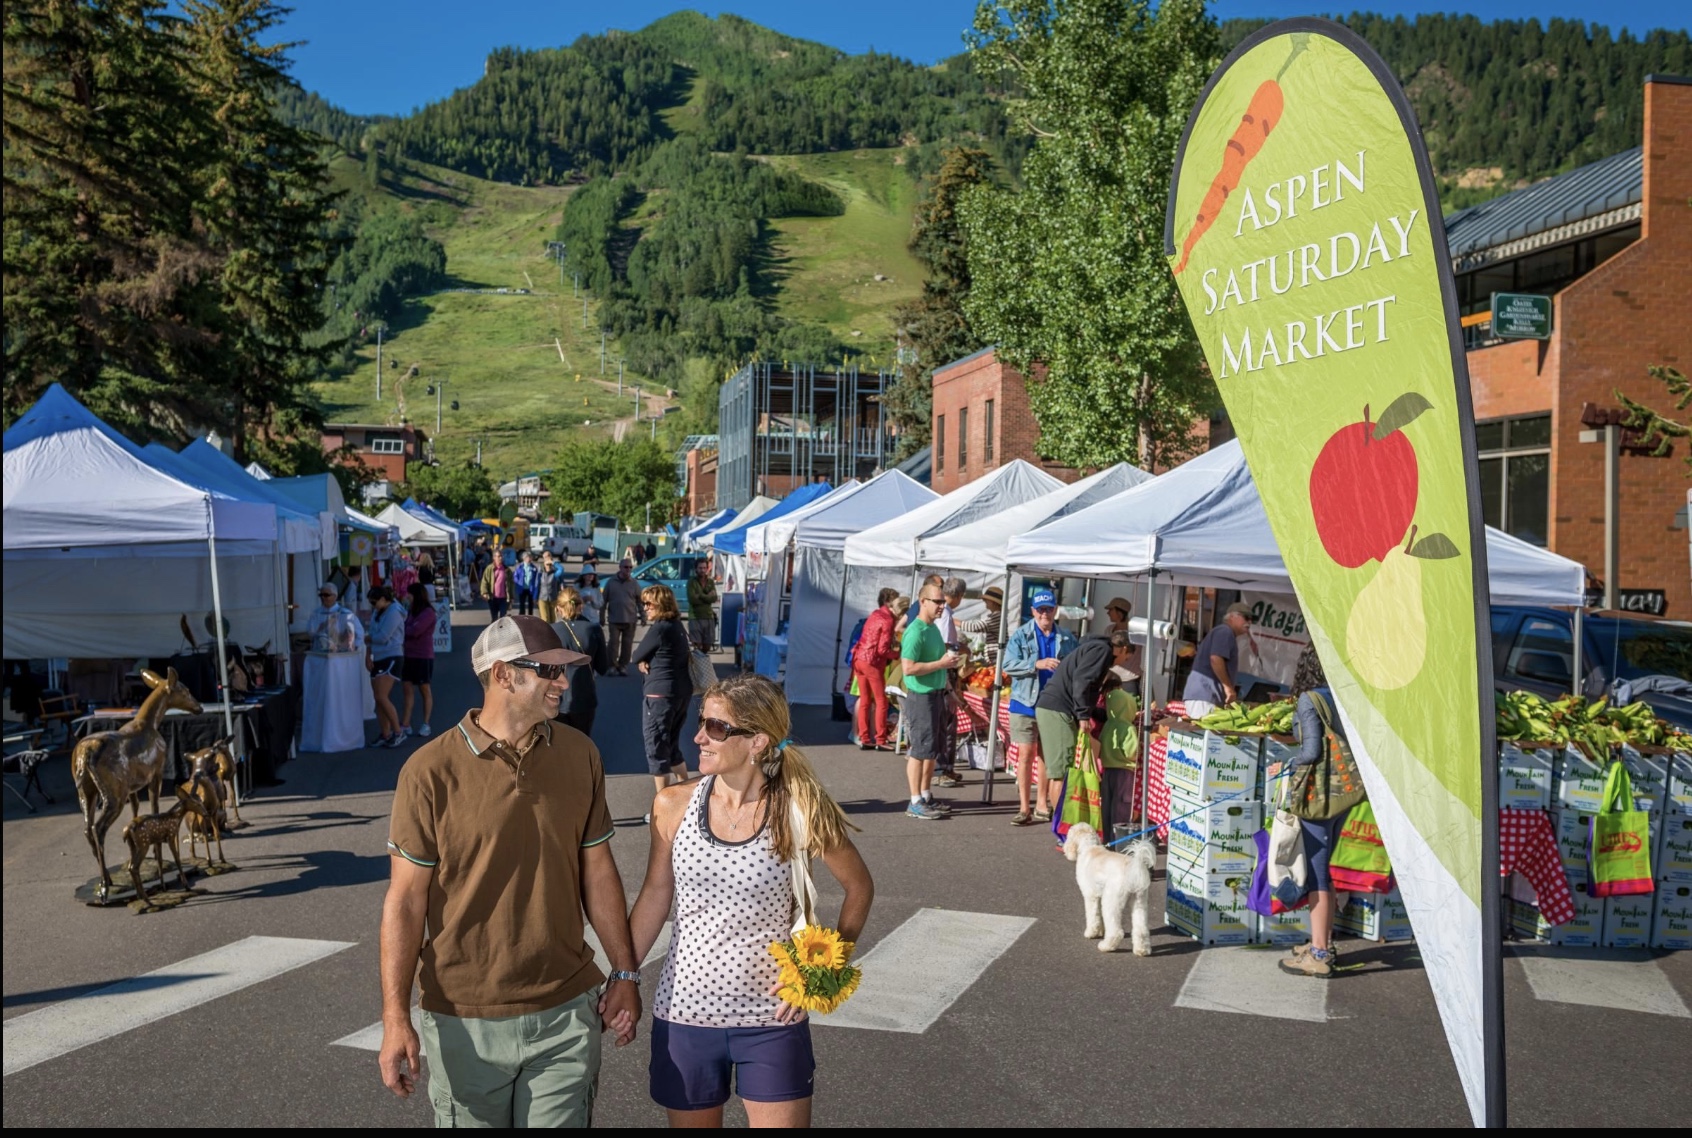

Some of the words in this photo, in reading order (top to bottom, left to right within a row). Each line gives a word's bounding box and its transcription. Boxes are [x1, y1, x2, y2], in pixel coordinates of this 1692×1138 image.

[1233, 149, 1366, 238] ASPEN
[1202, 209, 1419, 315] SATURDAY
[1219, 295, 1396, 379] MARKET
[1207, 756, 1249, 772] MOUNTAIN
[1217, 771, 1239, 782] FRESH
[1506, 766, 1545, 780] MOUNTAIN
[1515, 779, 1536, 790] FRESH
[1579, 780, 1599, 792] FRESH
[1211, 827, 1252, 842] MOUNTAIN
[1221, 842, 1243, 852] FRESH
[1220, 913, 1241, 923] FRESH
